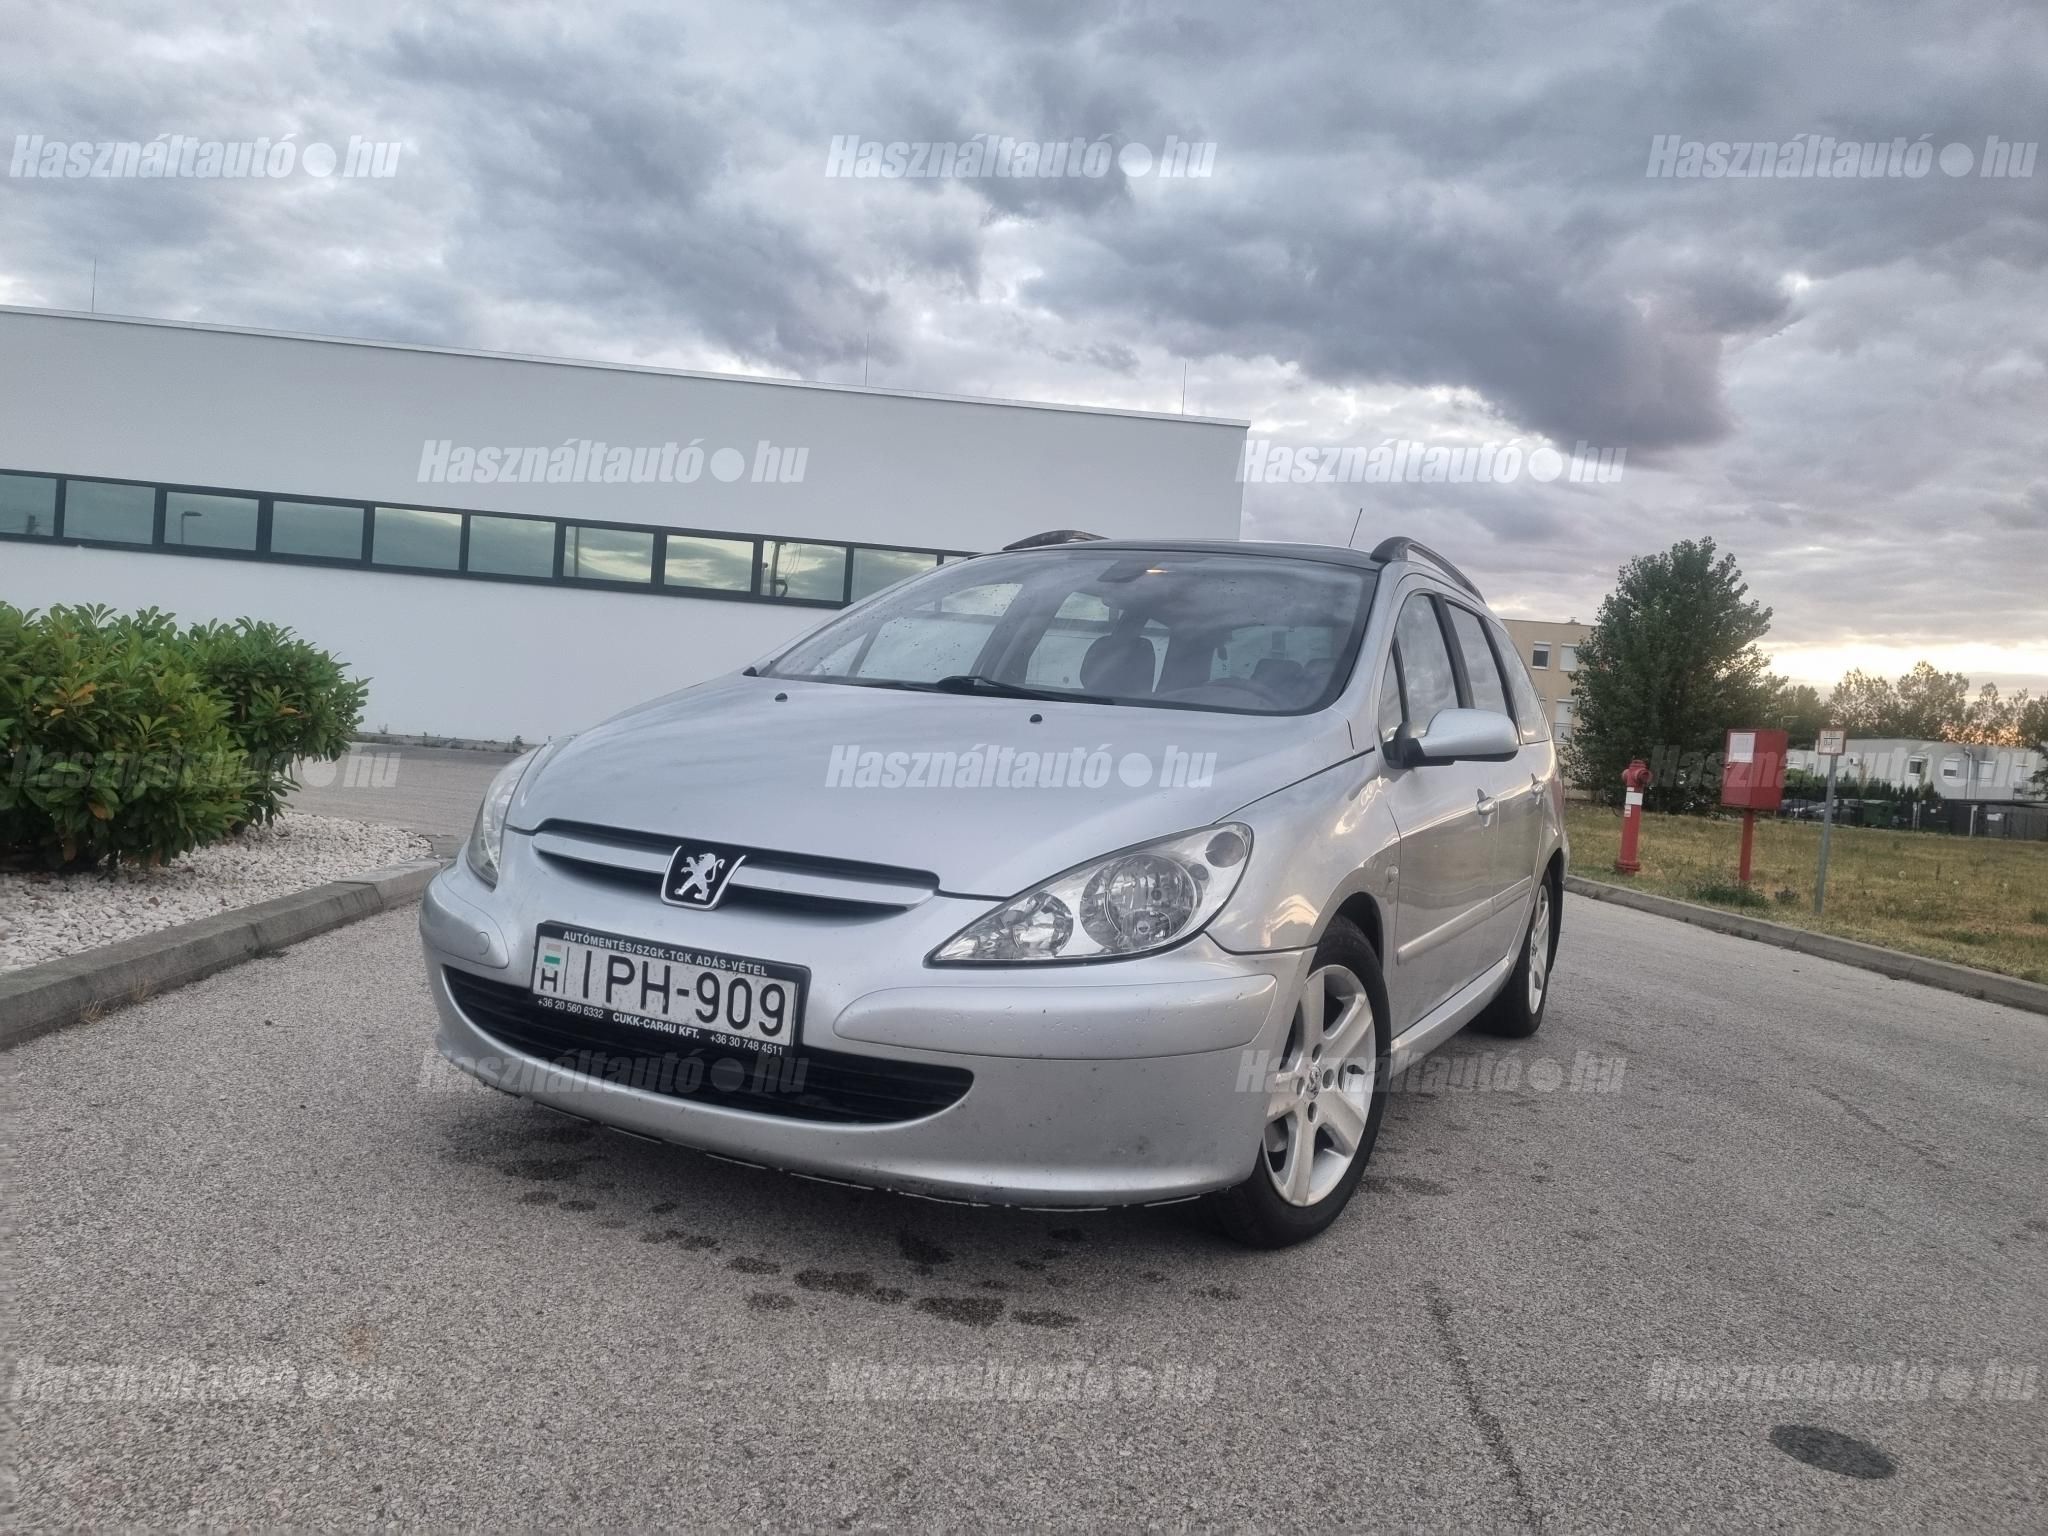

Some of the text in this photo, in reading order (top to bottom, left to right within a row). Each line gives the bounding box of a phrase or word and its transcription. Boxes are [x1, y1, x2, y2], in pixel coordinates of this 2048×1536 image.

[563, 931, 768, 977] AUTÓMENTÉS/SZGK-TGK ADÁS-VÉTEL
[582, 950, 786, 1037] IPH-909
[538, 997, 604, 1019] +36 20 560 6332
[612, 1012, 700, 1039] CUKK-CAR4U KFT.
[710, 1033, 783, 1056] +36 30 748 4511
